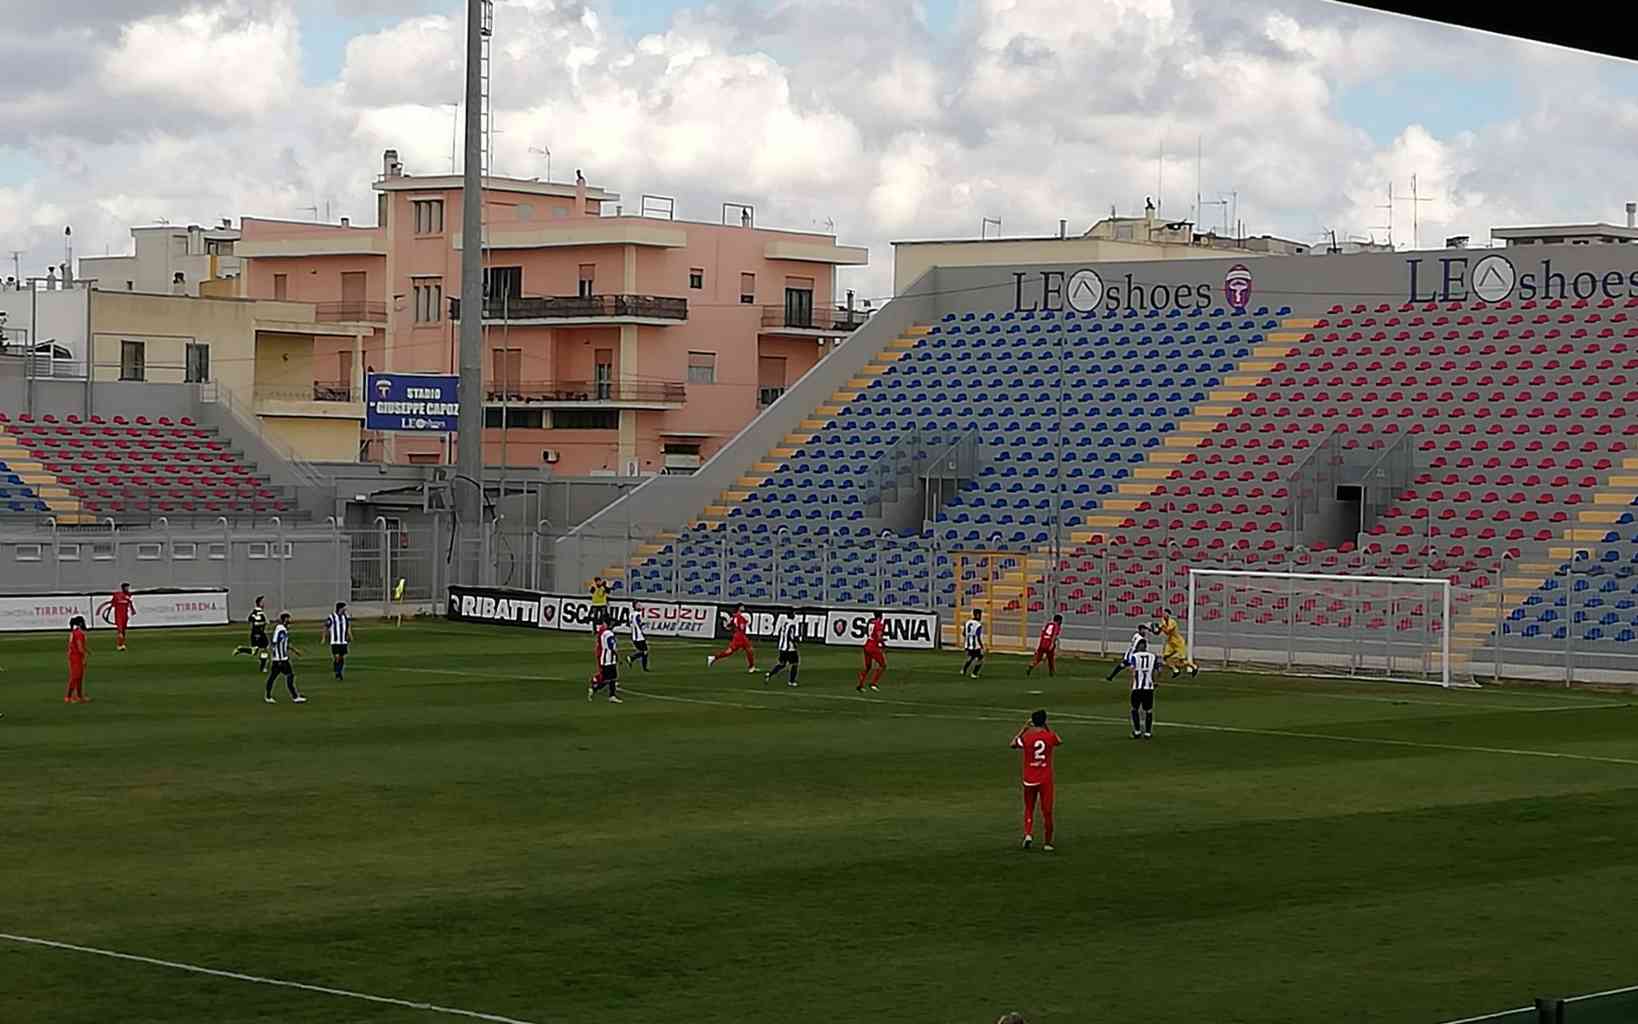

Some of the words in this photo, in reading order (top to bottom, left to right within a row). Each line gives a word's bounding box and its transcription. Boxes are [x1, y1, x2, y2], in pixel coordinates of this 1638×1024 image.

[407, 388, 441, 399] STADIO
[461, 594, 539, 623] RIBATTI
[562, 602, 631, 627] SCIA
[641, 607, 707, 620] ISUZU
[850, 616, 931, 642] SANIA
[1140, 655, 1149, 669] 11
[1033, 739, 1046, 760] 2
